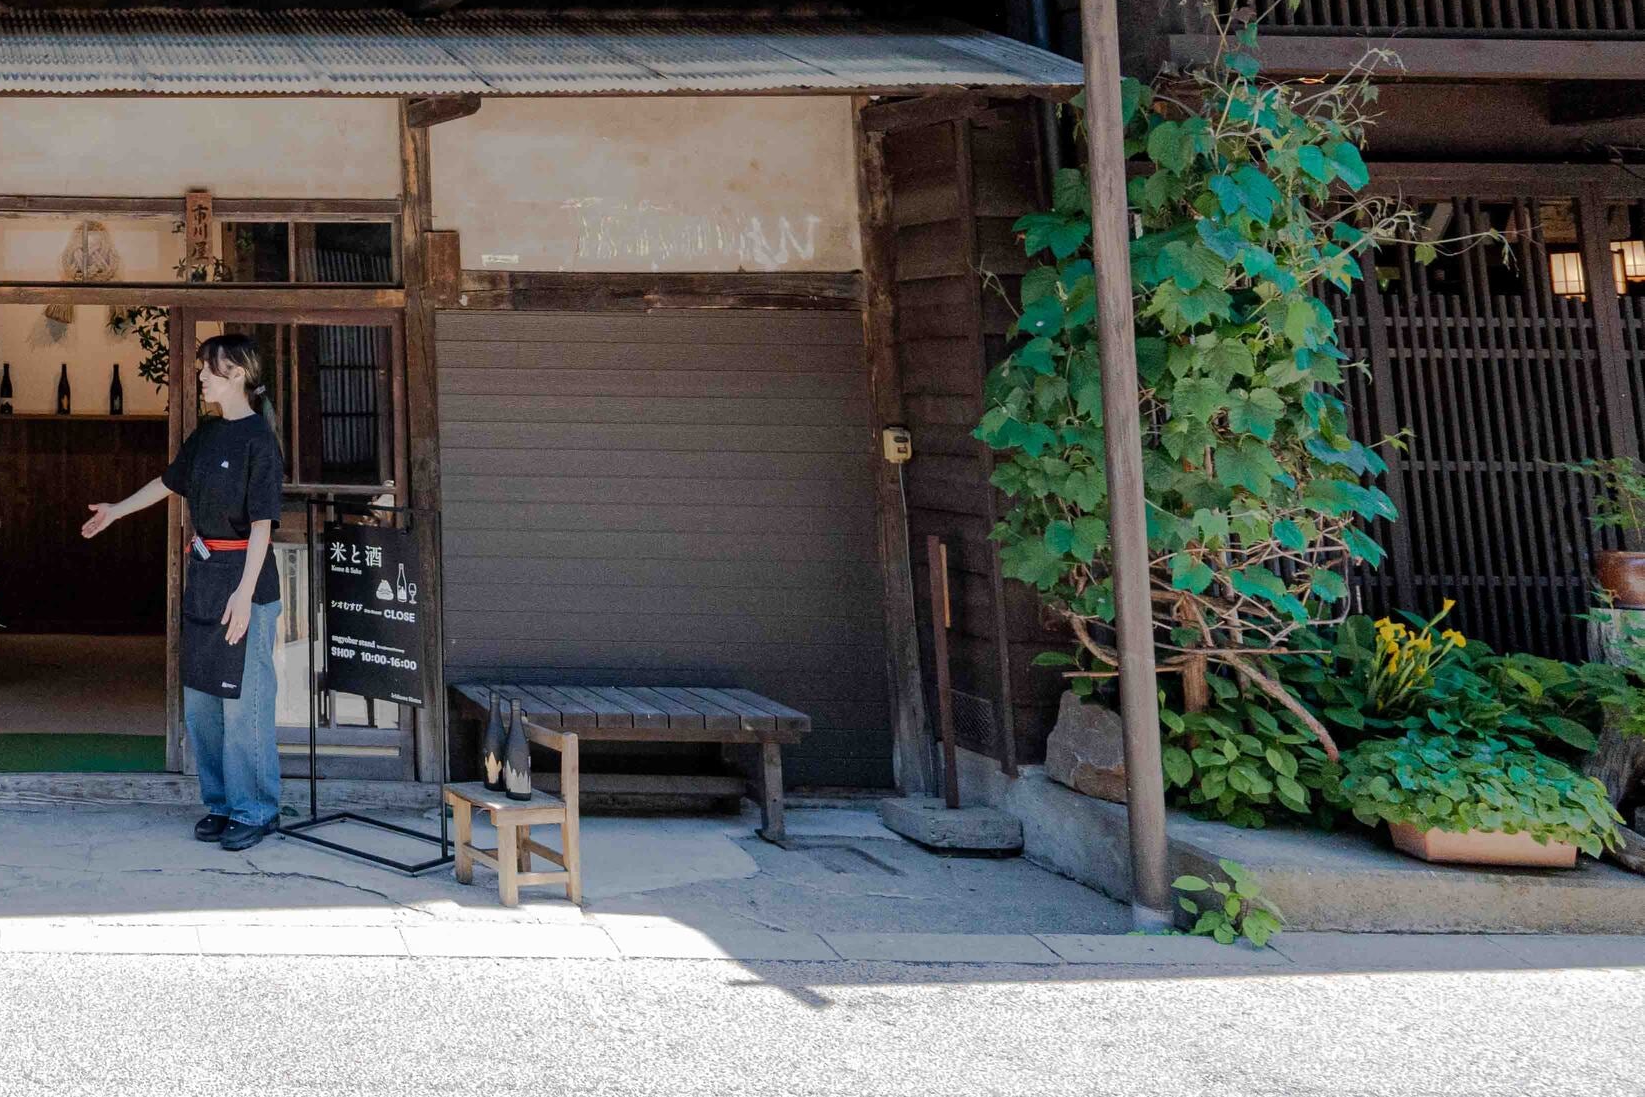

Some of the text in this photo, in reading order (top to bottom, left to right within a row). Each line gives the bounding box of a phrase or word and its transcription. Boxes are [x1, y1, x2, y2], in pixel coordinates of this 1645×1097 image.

[330, 541, 382, 568] 米と酒
[384, 609, 416, 623] CLOSE
[331, 646, 417, 671] SHOP 10:00-16:00
